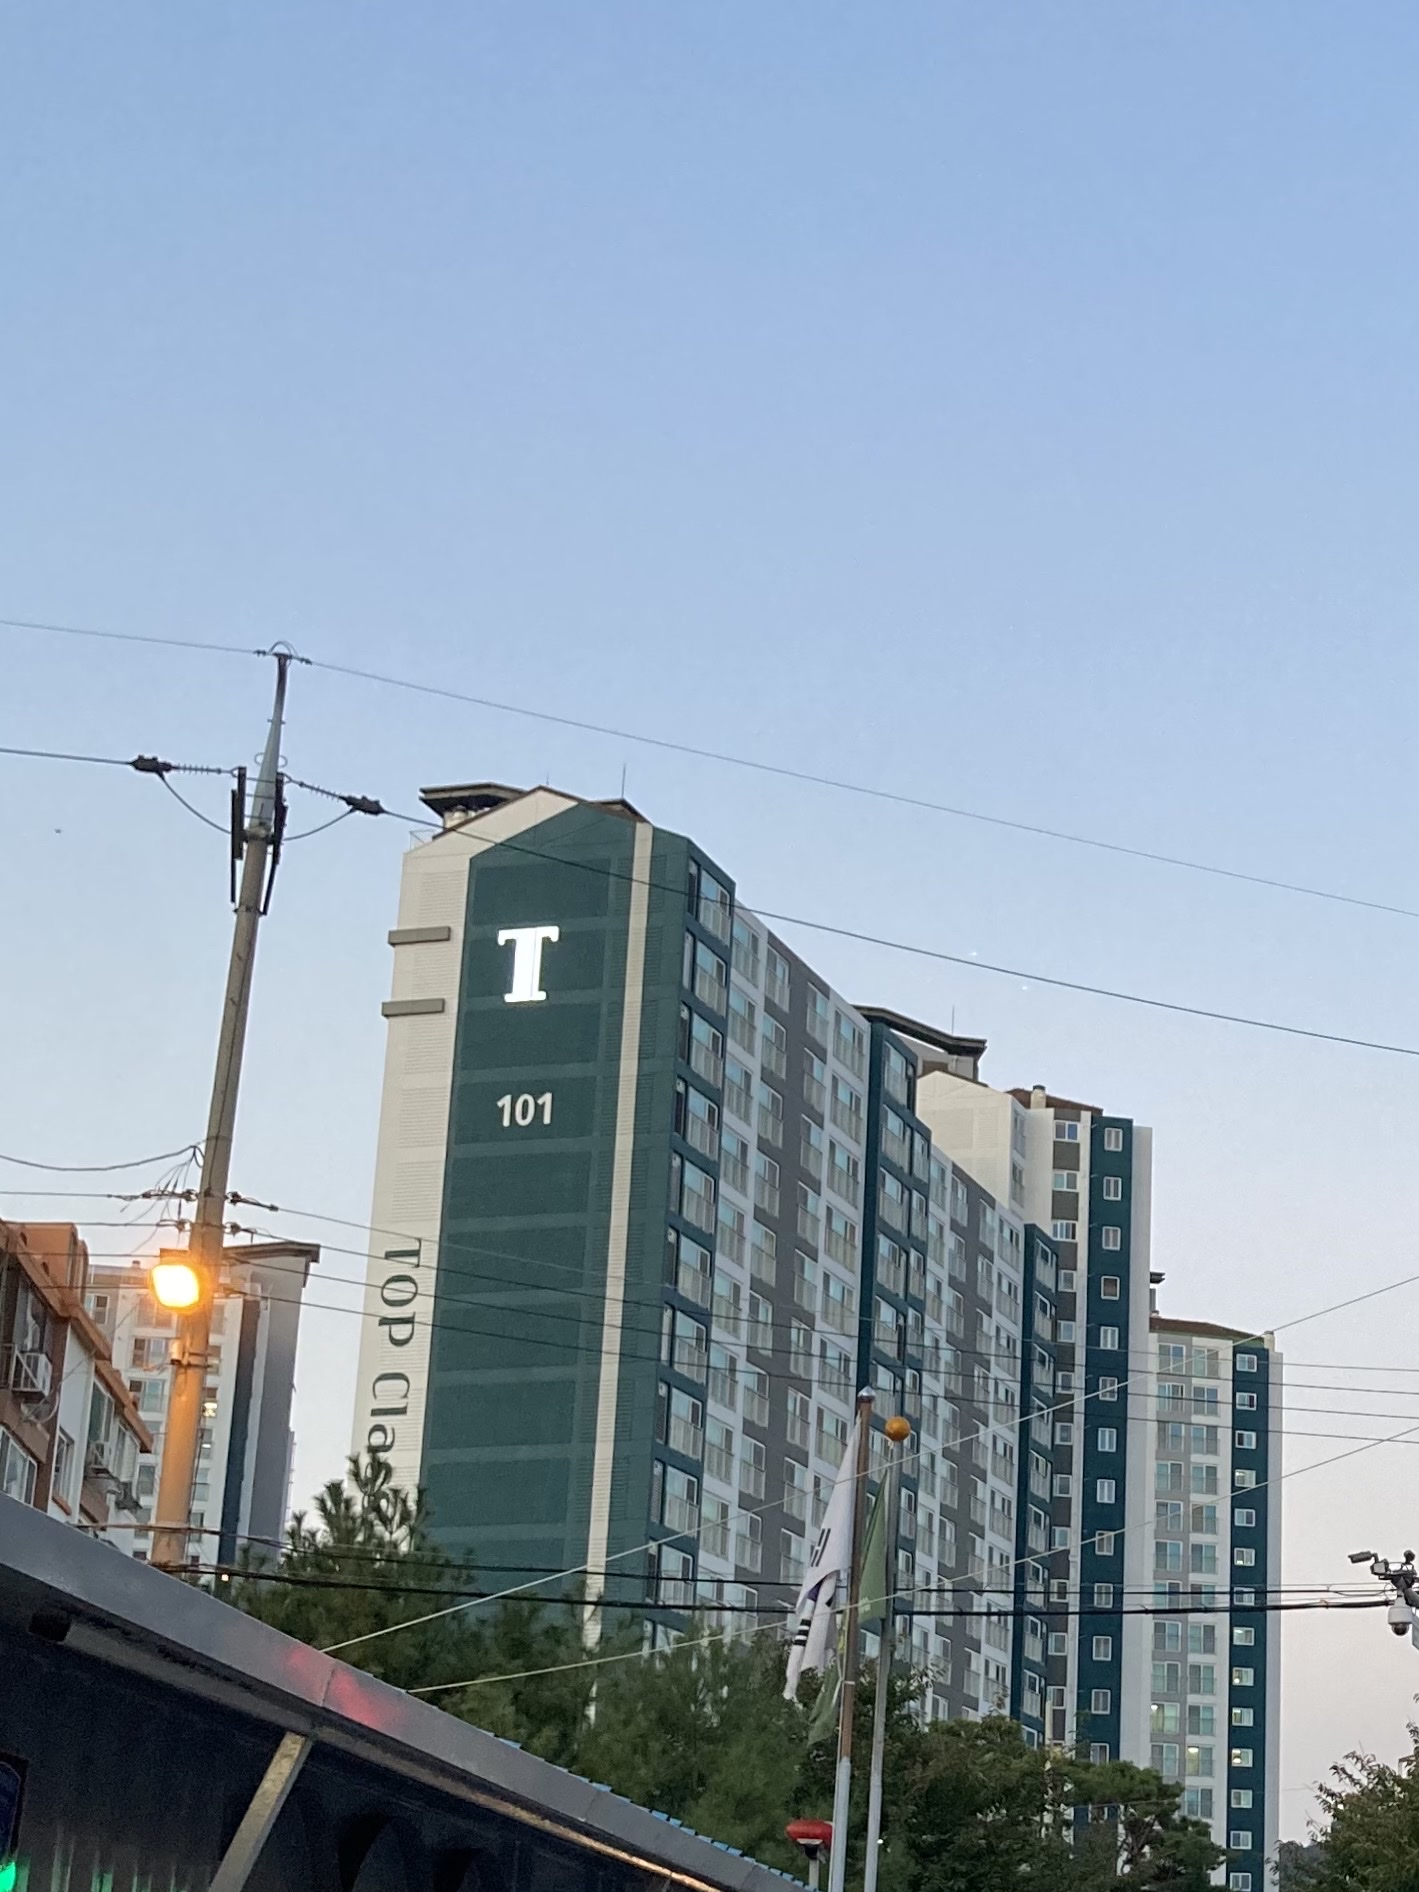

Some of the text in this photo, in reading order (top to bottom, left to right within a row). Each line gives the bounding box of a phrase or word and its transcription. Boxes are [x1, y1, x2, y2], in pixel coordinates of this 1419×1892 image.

[497, 925, 560, 1003] T
[496, 1093, 554, 1128] 101
[378, 1238, 422, 1350] TOP
